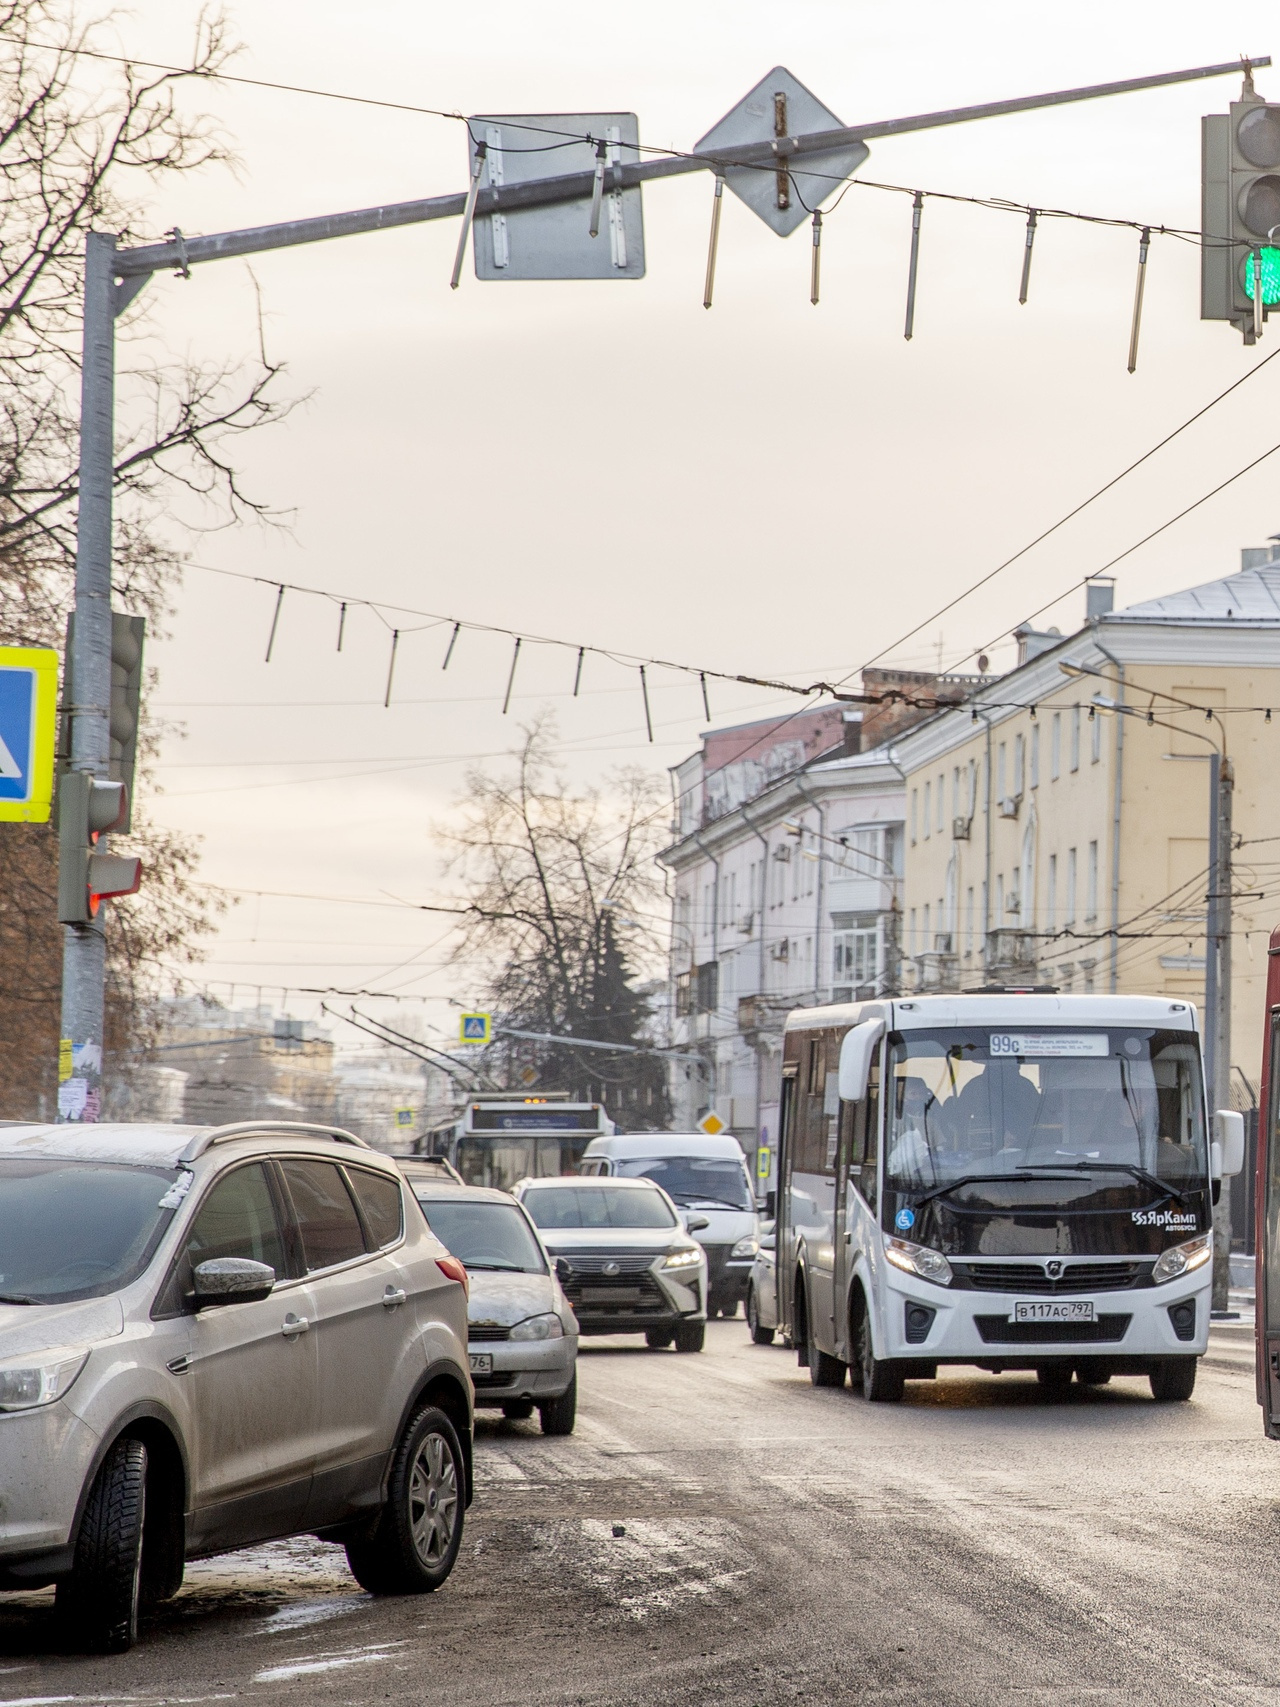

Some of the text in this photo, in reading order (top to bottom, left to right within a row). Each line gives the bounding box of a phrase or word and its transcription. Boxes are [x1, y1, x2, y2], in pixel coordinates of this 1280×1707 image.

[1148, 1211, 1196, 1226] ЯрКамп
[1071, 1303, 1089, 1313] 797
[471, 1356, 486, 1368] 76
